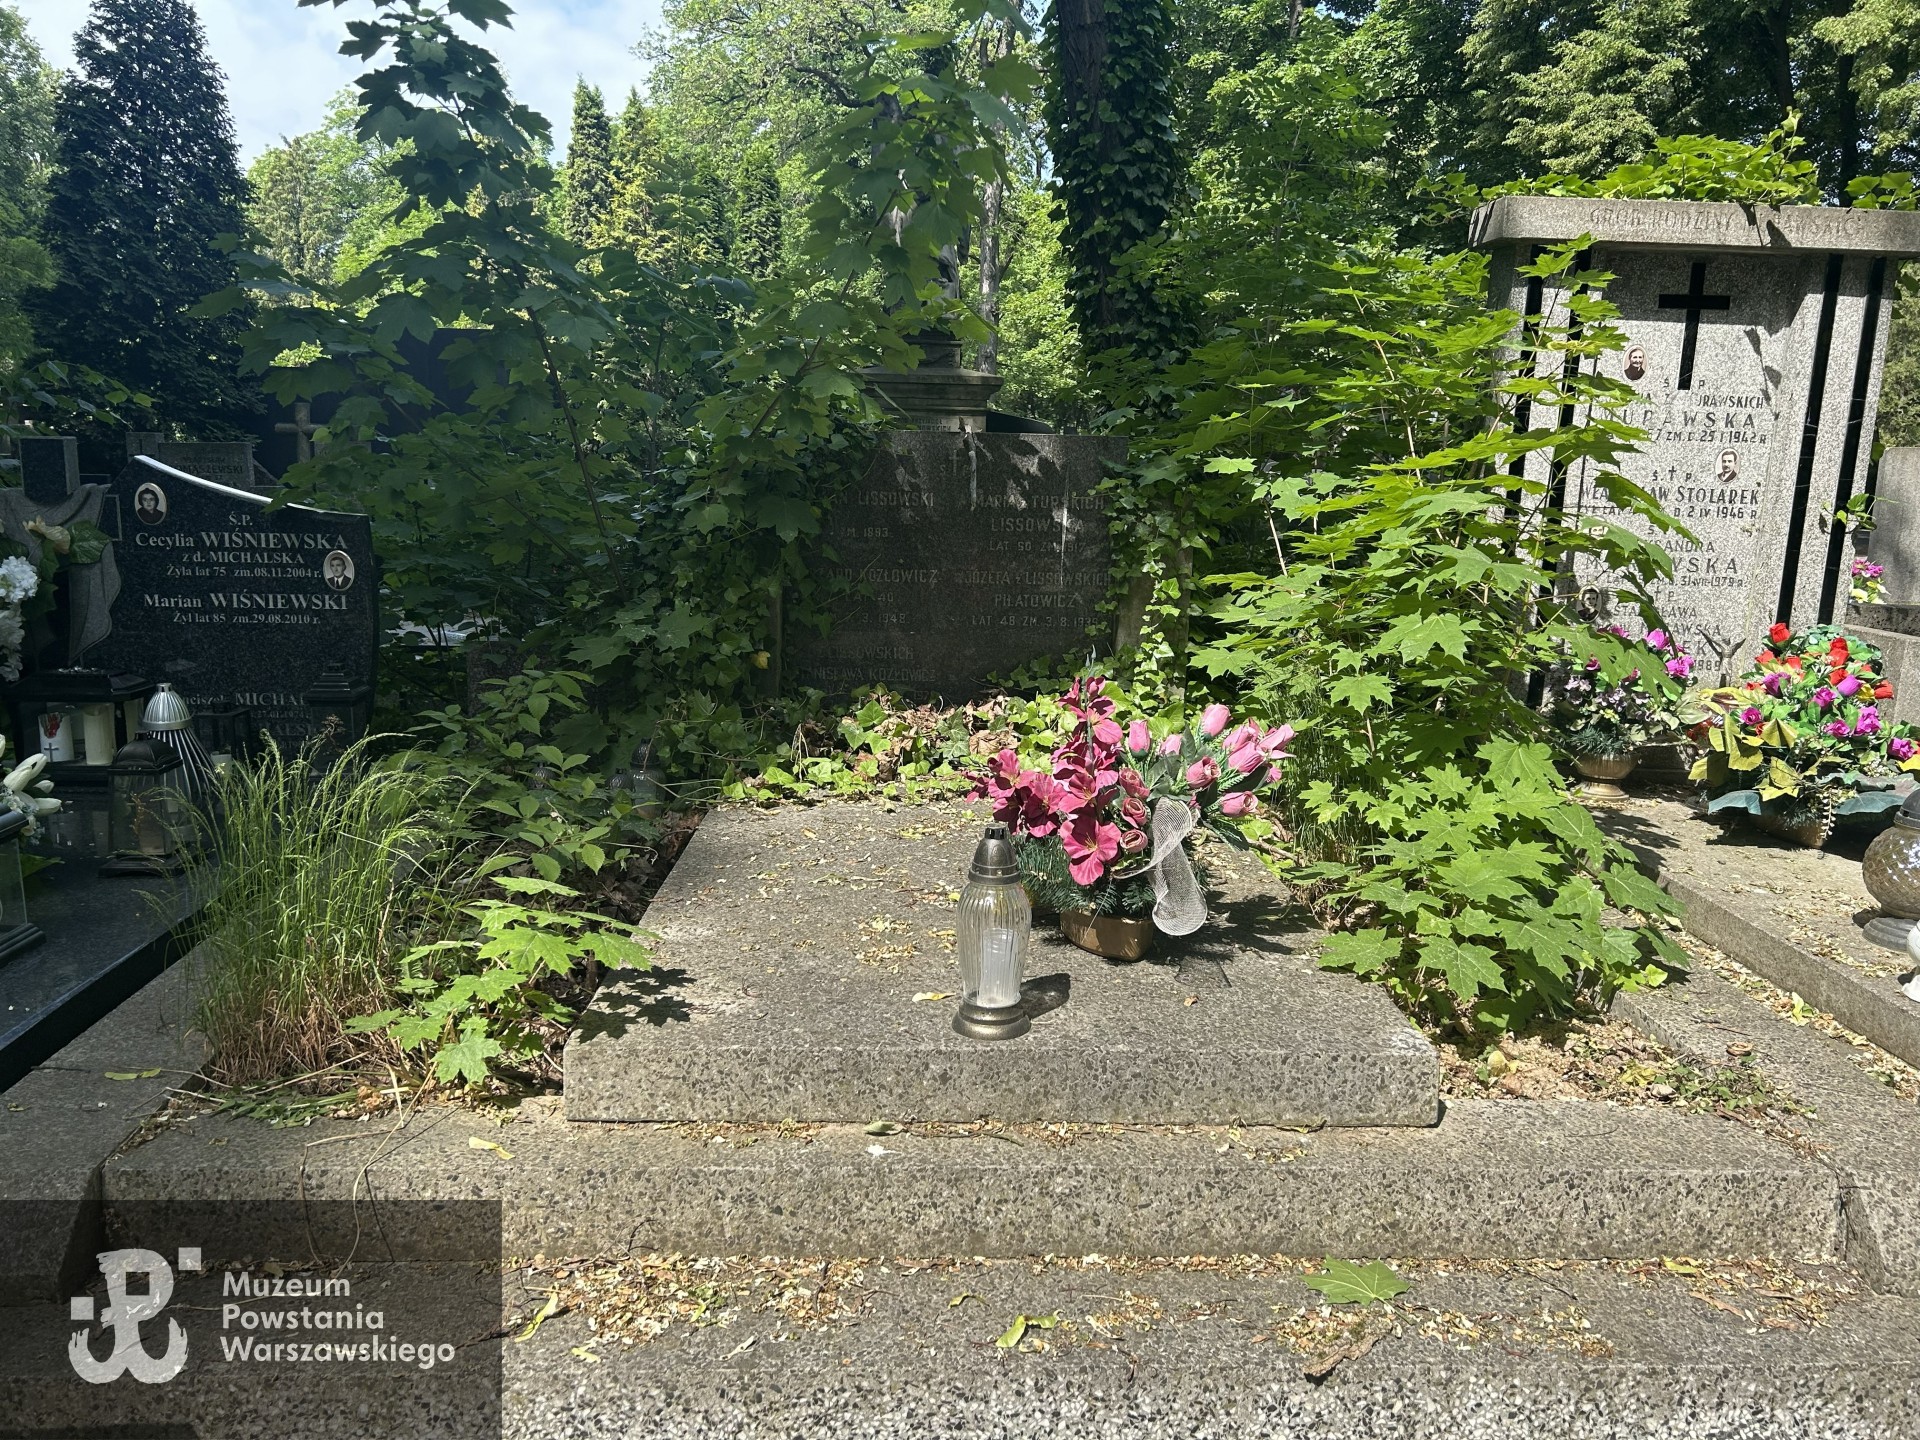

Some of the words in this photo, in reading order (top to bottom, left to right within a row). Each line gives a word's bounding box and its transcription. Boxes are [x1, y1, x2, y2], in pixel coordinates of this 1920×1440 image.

[1728, 431, 1757, 444] 1942
[858, 490, 934, 507] LISSOWSKI
[1030, 494, 1105, 510] TURSKICH
[1675, 485, 1759, 505] STOLAREK
[229, 511, 254, 526] Ś.P.
[1715, 505, 1744, 519] 1946
[135, 532, 195, 550] Cecylia
[200, 529, 348, 550] WIŚNIEWSKA
[182, 552, 190, 562] z
[193, 551, 206, 563] d.
[209, 551, 305, 565] MICHALSKA
[195, 566, 210, 576] lat
[213, 566, 227, 577] 75
[859, 568, 938, 583] KOZŁOWICZ
[1024, 570, 1111, 586] LISSOWSKICH
[143, 593, 203, 608] Marian
[209, 588, 348, 610] WIŚNIEWSKI
[994, 593, 1077, 608] PIŁATOWICZ
[194, 613, 210, 623] lat
[213, 613, 227, 623] 85
[1000, 616, 1016, 626] 48
